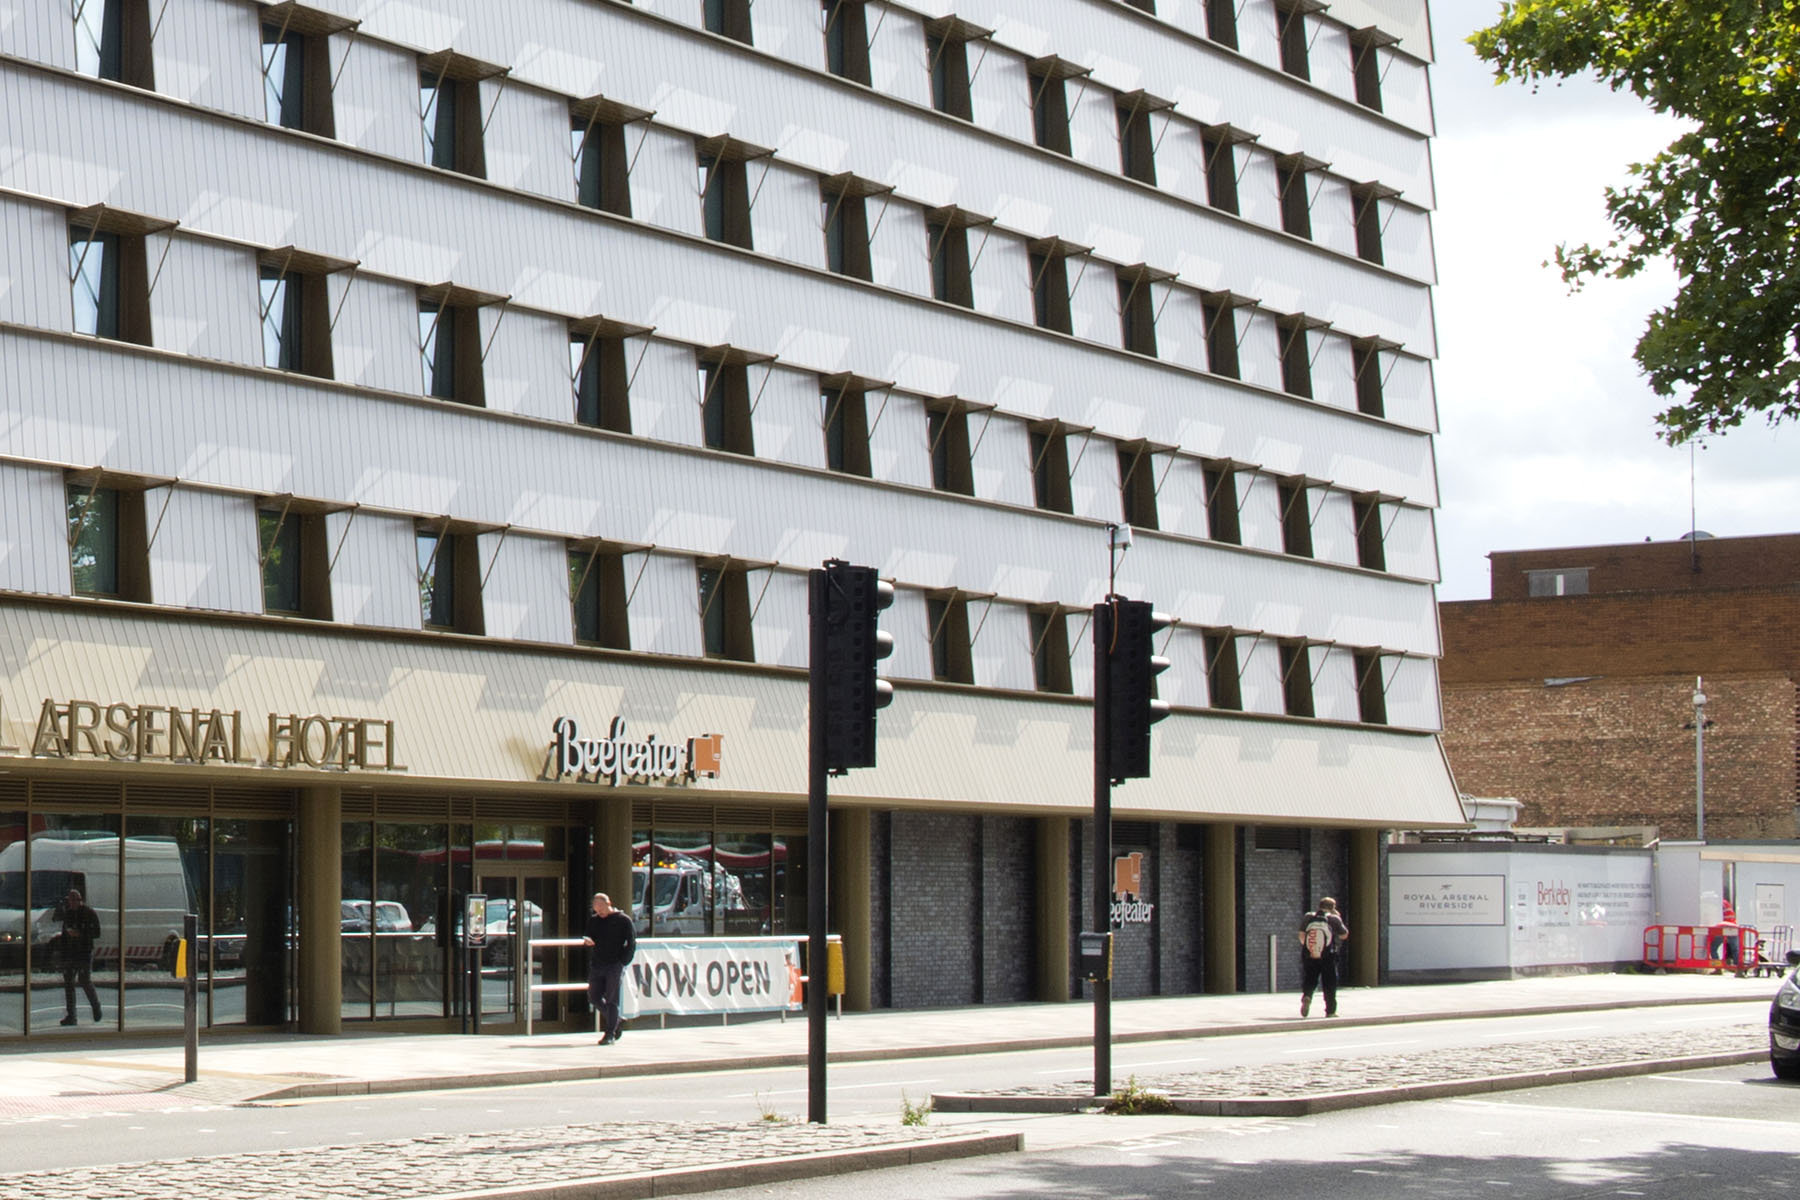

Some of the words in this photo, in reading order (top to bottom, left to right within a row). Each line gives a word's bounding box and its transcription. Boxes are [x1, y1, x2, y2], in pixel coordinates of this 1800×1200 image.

[31, 698, 257, 764] ARSENAL
[267, 712, 409, 772] HOTEL
[555, 714, 688, 788] Beefeater
[1110, 890, 1155, 929] eefeater
[1403, 894, 1437, 902] ROYAL
[1442, 894, 1489, 902] ARSENAL
[632, 961, 698, 998] NOW
[706, 960, 771, 997] OPEN
